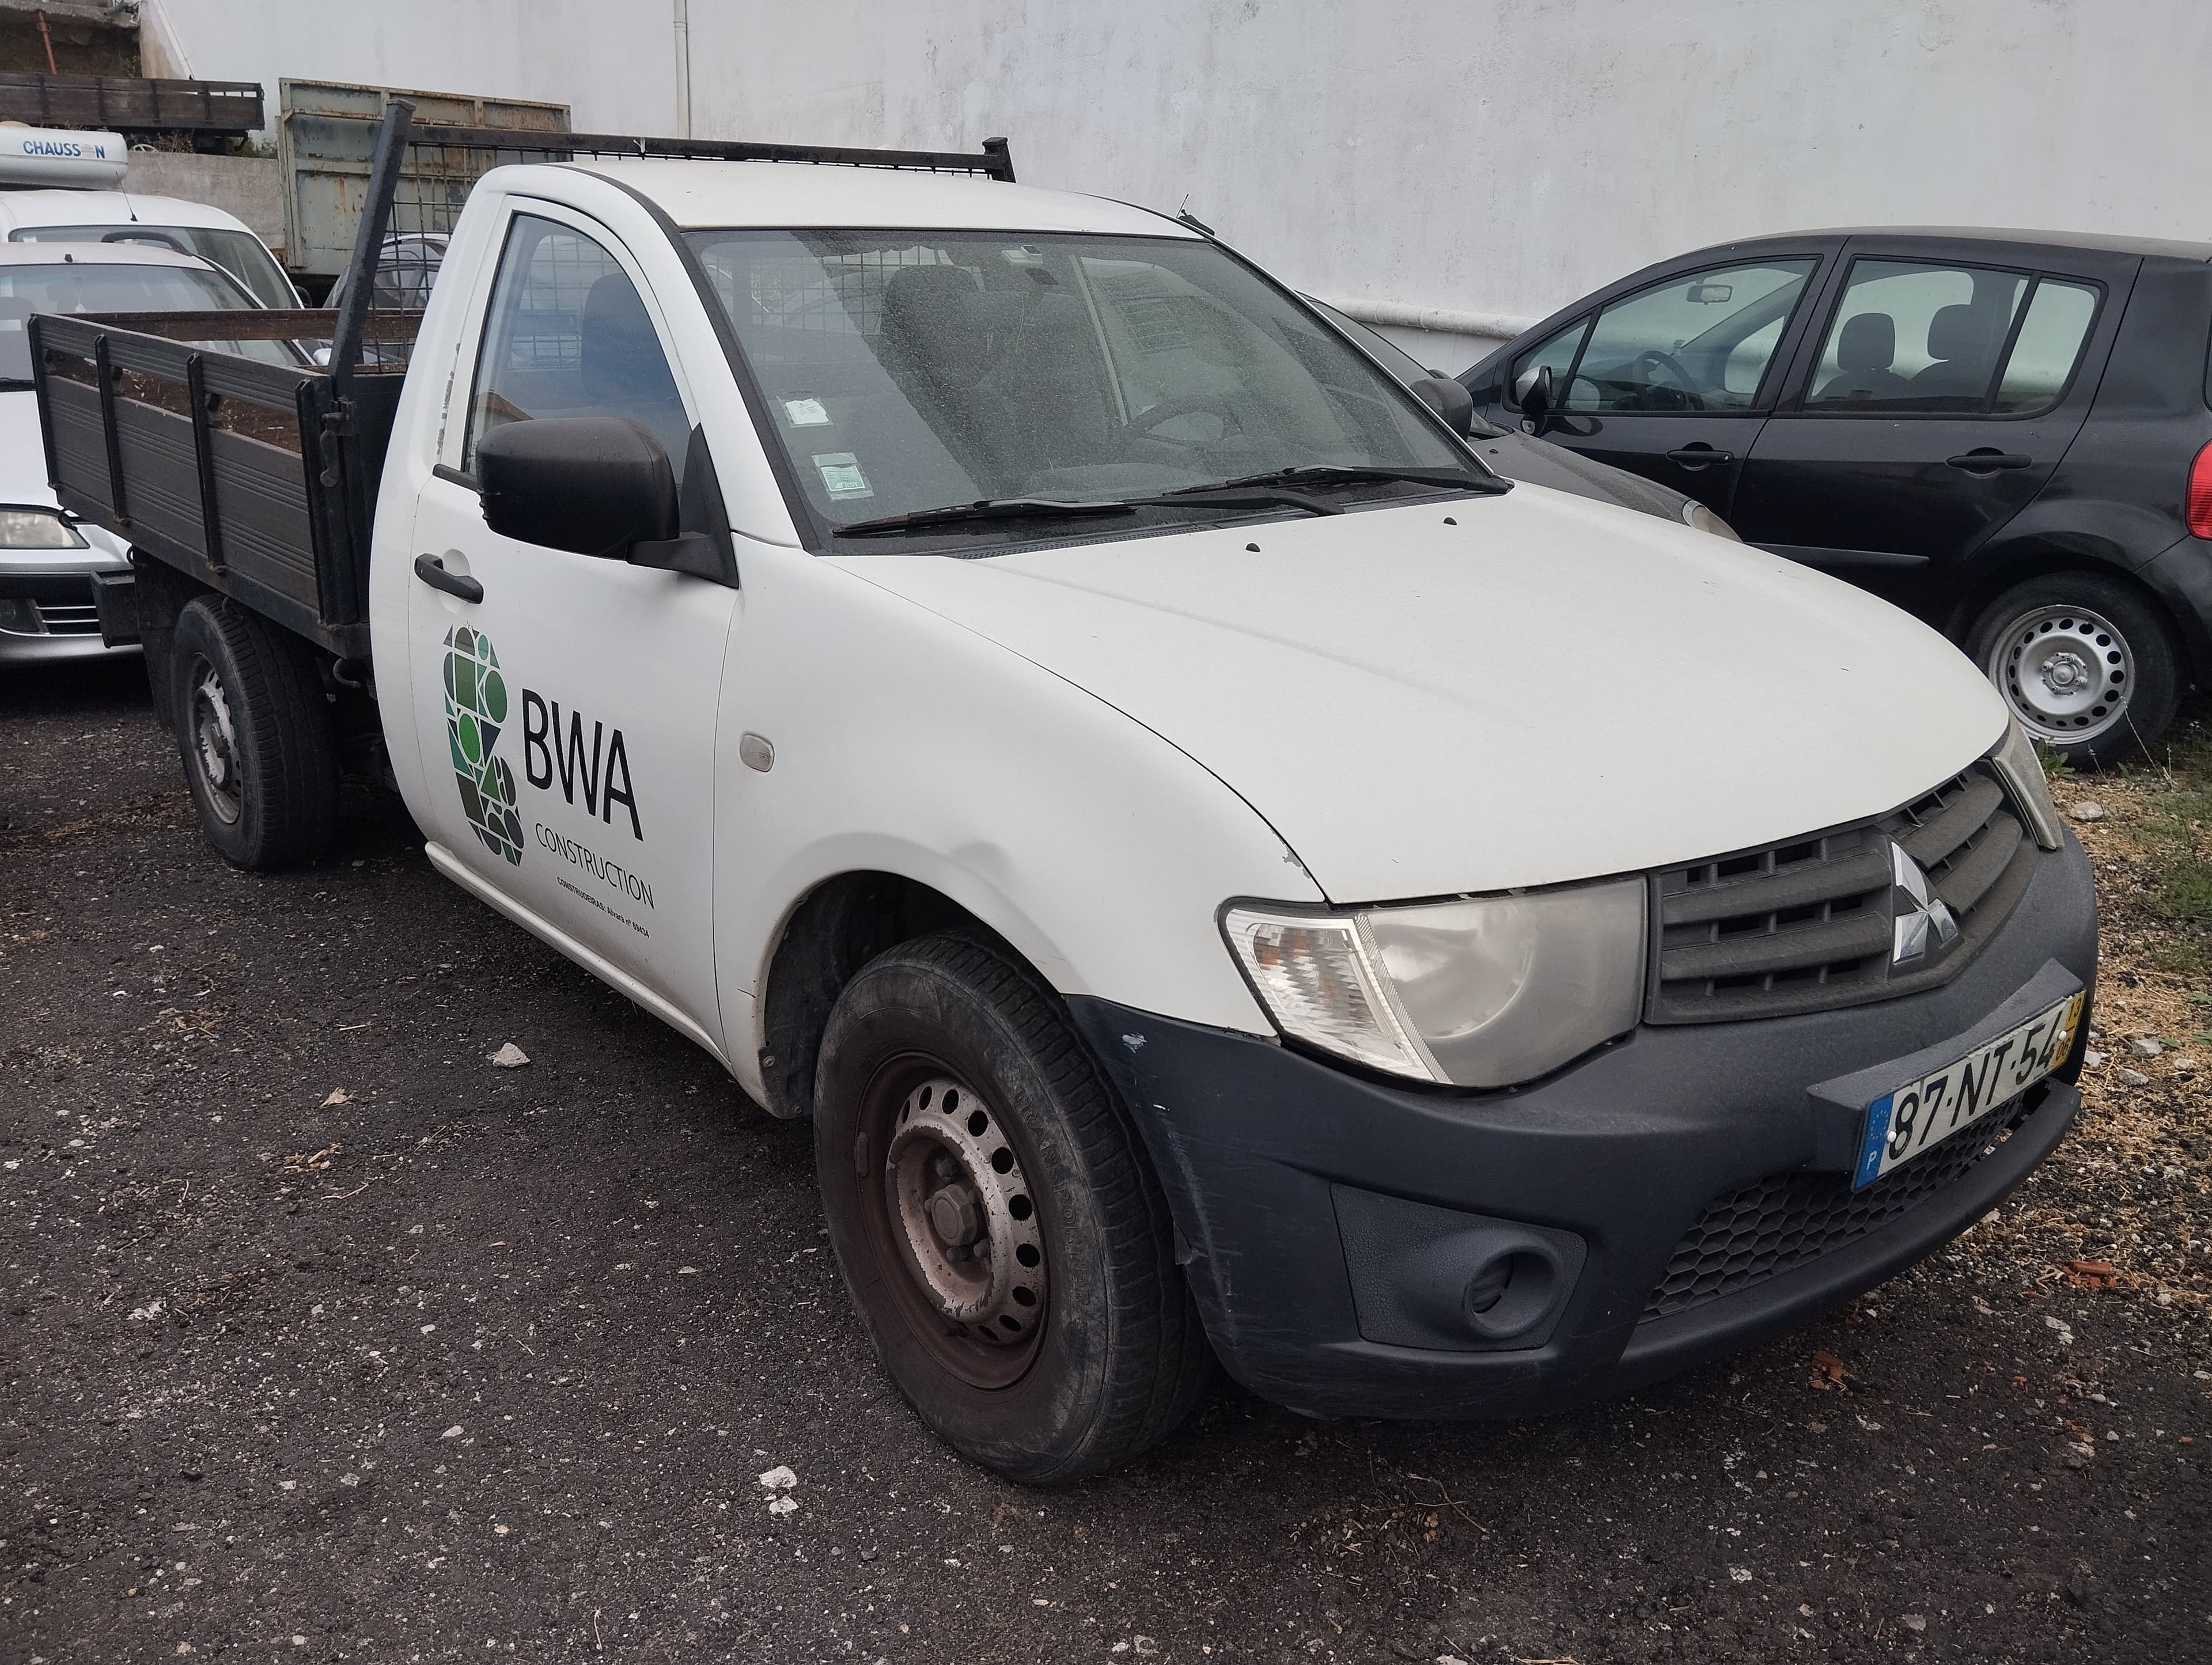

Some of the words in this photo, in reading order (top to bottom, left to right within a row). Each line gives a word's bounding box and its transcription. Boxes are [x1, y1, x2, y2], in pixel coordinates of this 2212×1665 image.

[522, 688, 643, 842] BWA
[535, 822, 654, 909] CONSTRUCTION
[1889, 1010, 2063, 1160] 87-NT-54
[1866, 1151, 1877, 1170] P
